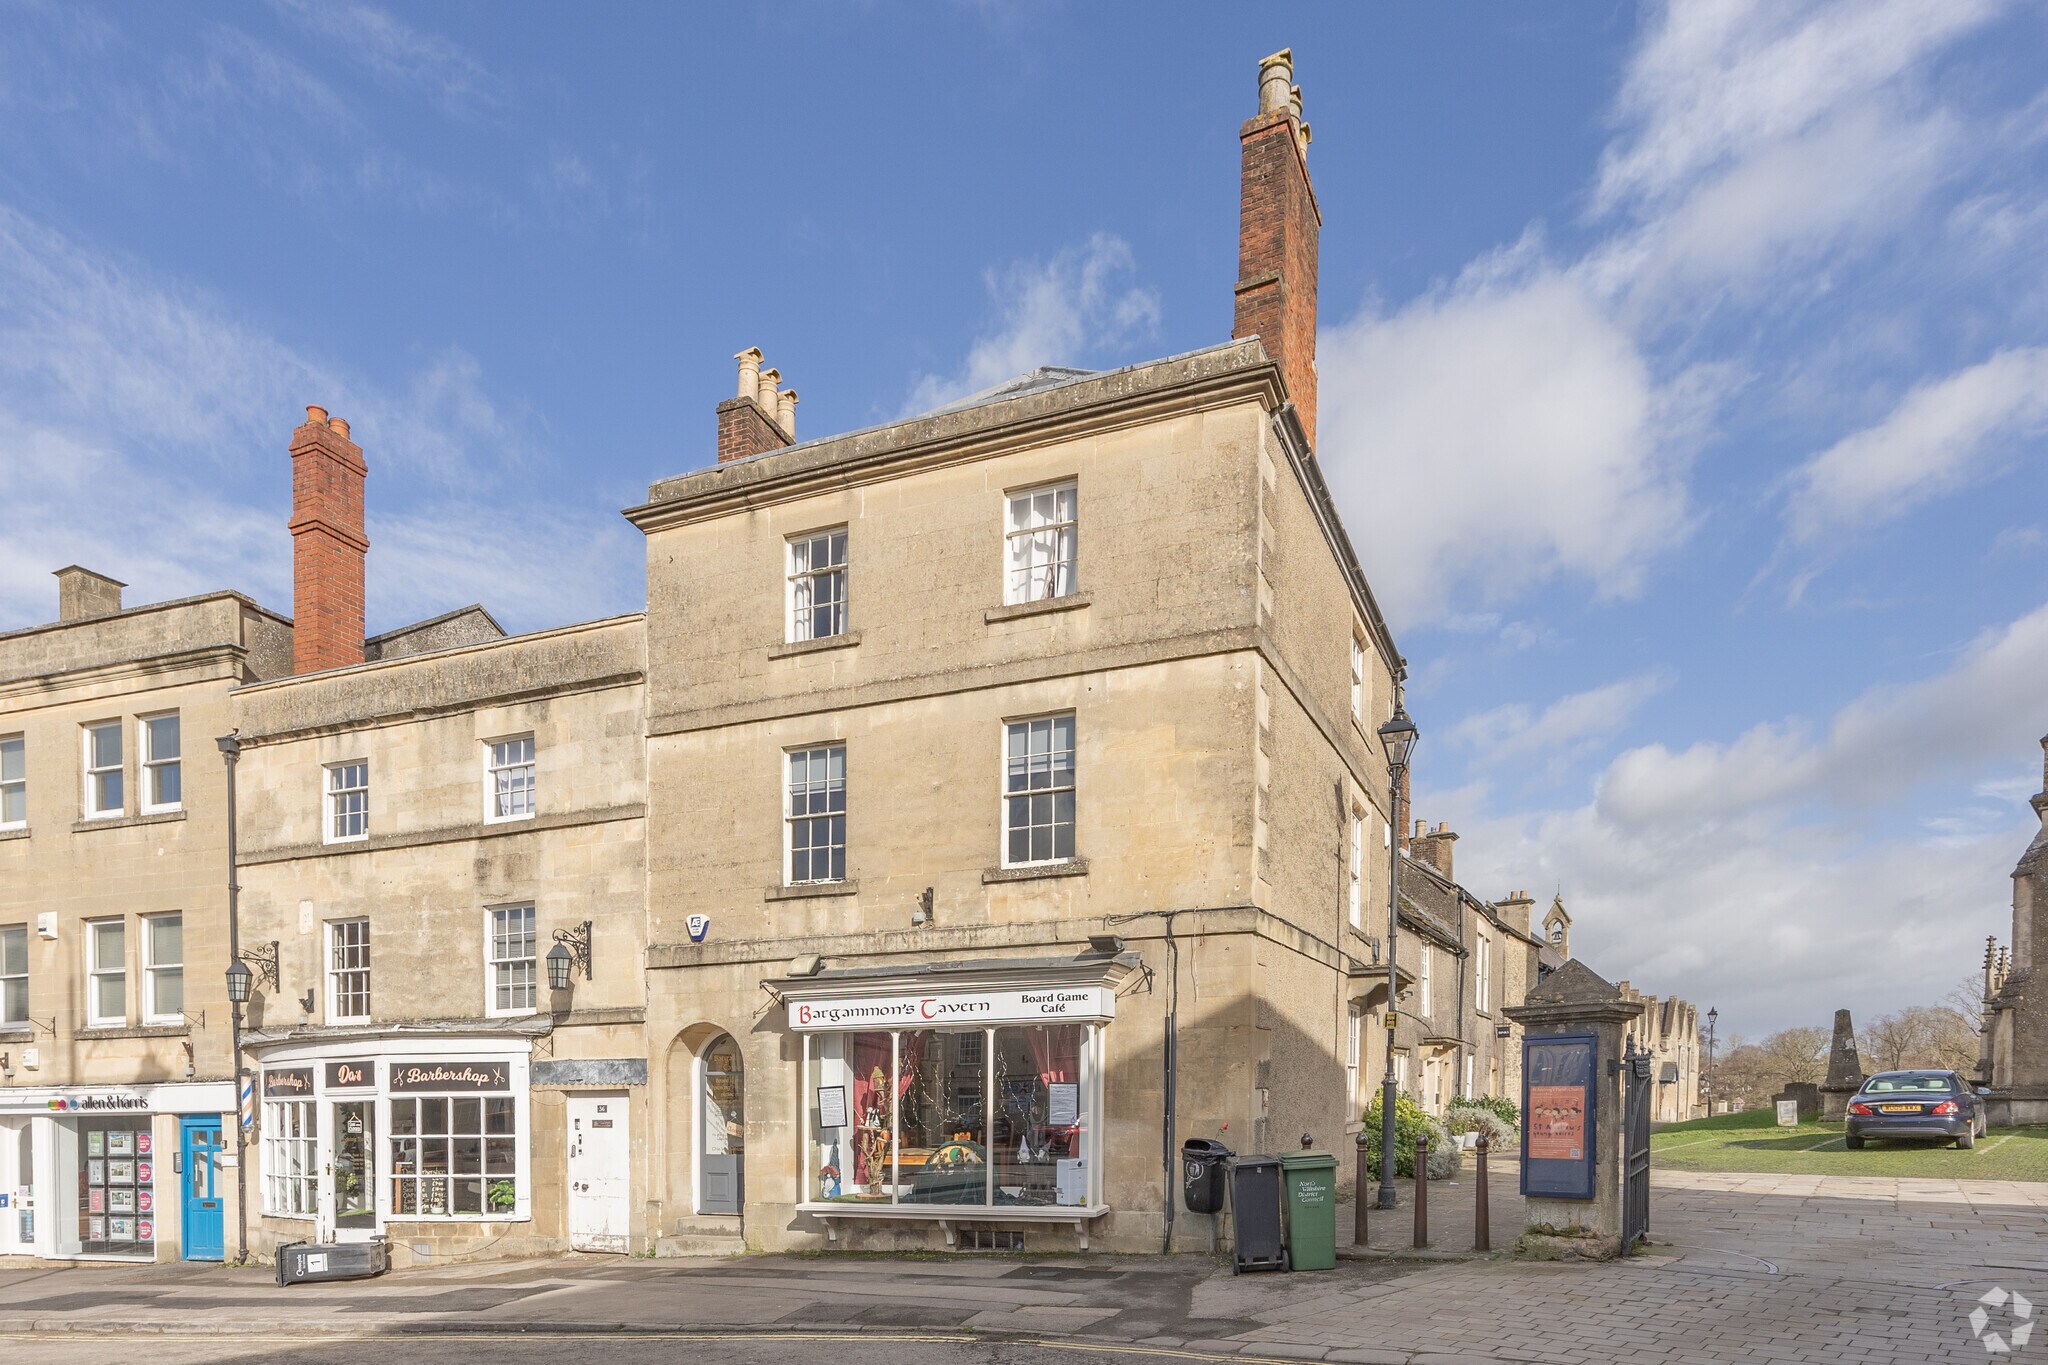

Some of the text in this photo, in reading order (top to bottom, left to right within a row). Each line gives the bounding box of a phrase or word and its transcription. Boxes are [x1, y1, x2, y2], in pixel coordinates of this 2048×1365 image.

[1021, 993, 1088, 1003] Board Game
[798, 998, 990, 1025] Bargammon's Tavern
[1041, 1003, 1066, 1013] Café
[268, 1072, 303, 1091] Barbershop
[406, 1066, 490, 1087] Barbershop
[81, 1095, 148, 1110] allen & harris
